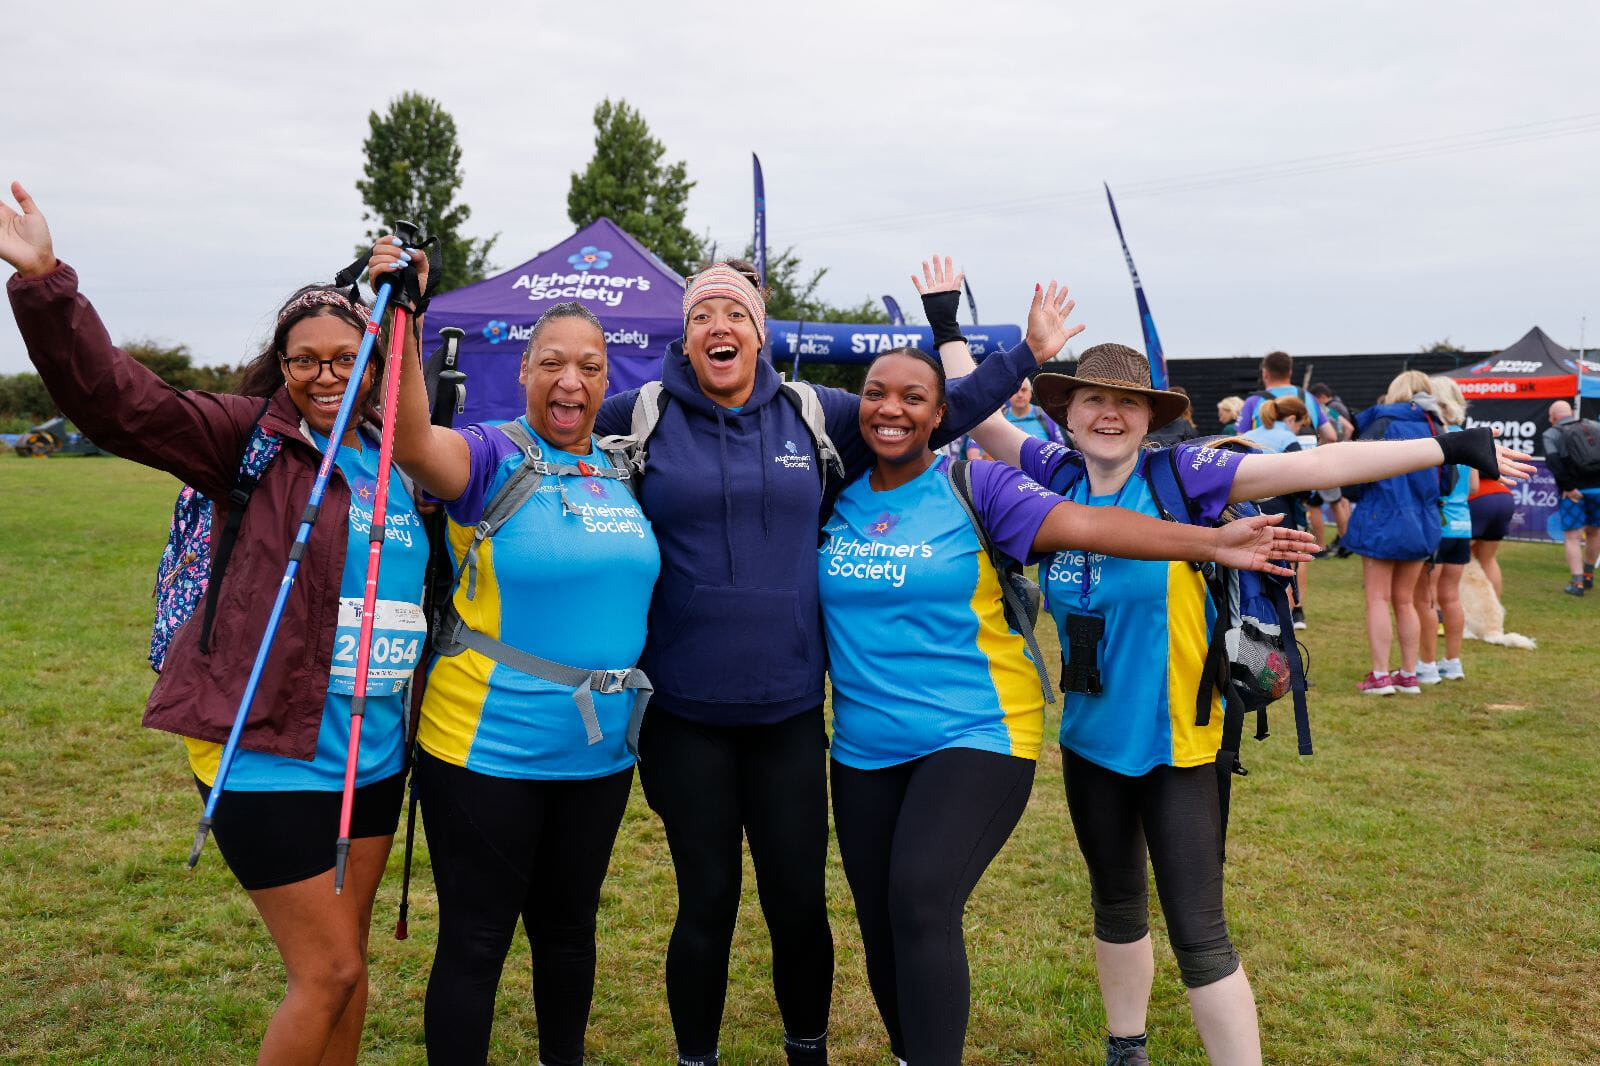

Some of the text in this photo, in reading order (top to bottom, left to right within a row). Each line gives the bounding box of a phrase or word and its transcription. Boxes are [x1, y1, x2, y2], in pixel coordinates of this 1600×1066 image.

[512, 271, 651, 291] Alzheimer's
[529, 284, 623, 306] Society
[604, 329, 648, 348] ociety
[786, 338, 830, 355] Tek26
[851, 333, 922, 353] START
[1512, 483, 1558, 507] ek26
[350, 516, 412, 547] Soety
[583, 516, 645, 538] Society
[820, 535, 932, 558] Alzheimer's
[827, 555, 906, 587] Society
[1048, 564, 1102, 585] Socty
[334, 634, 418, 664] 2054
